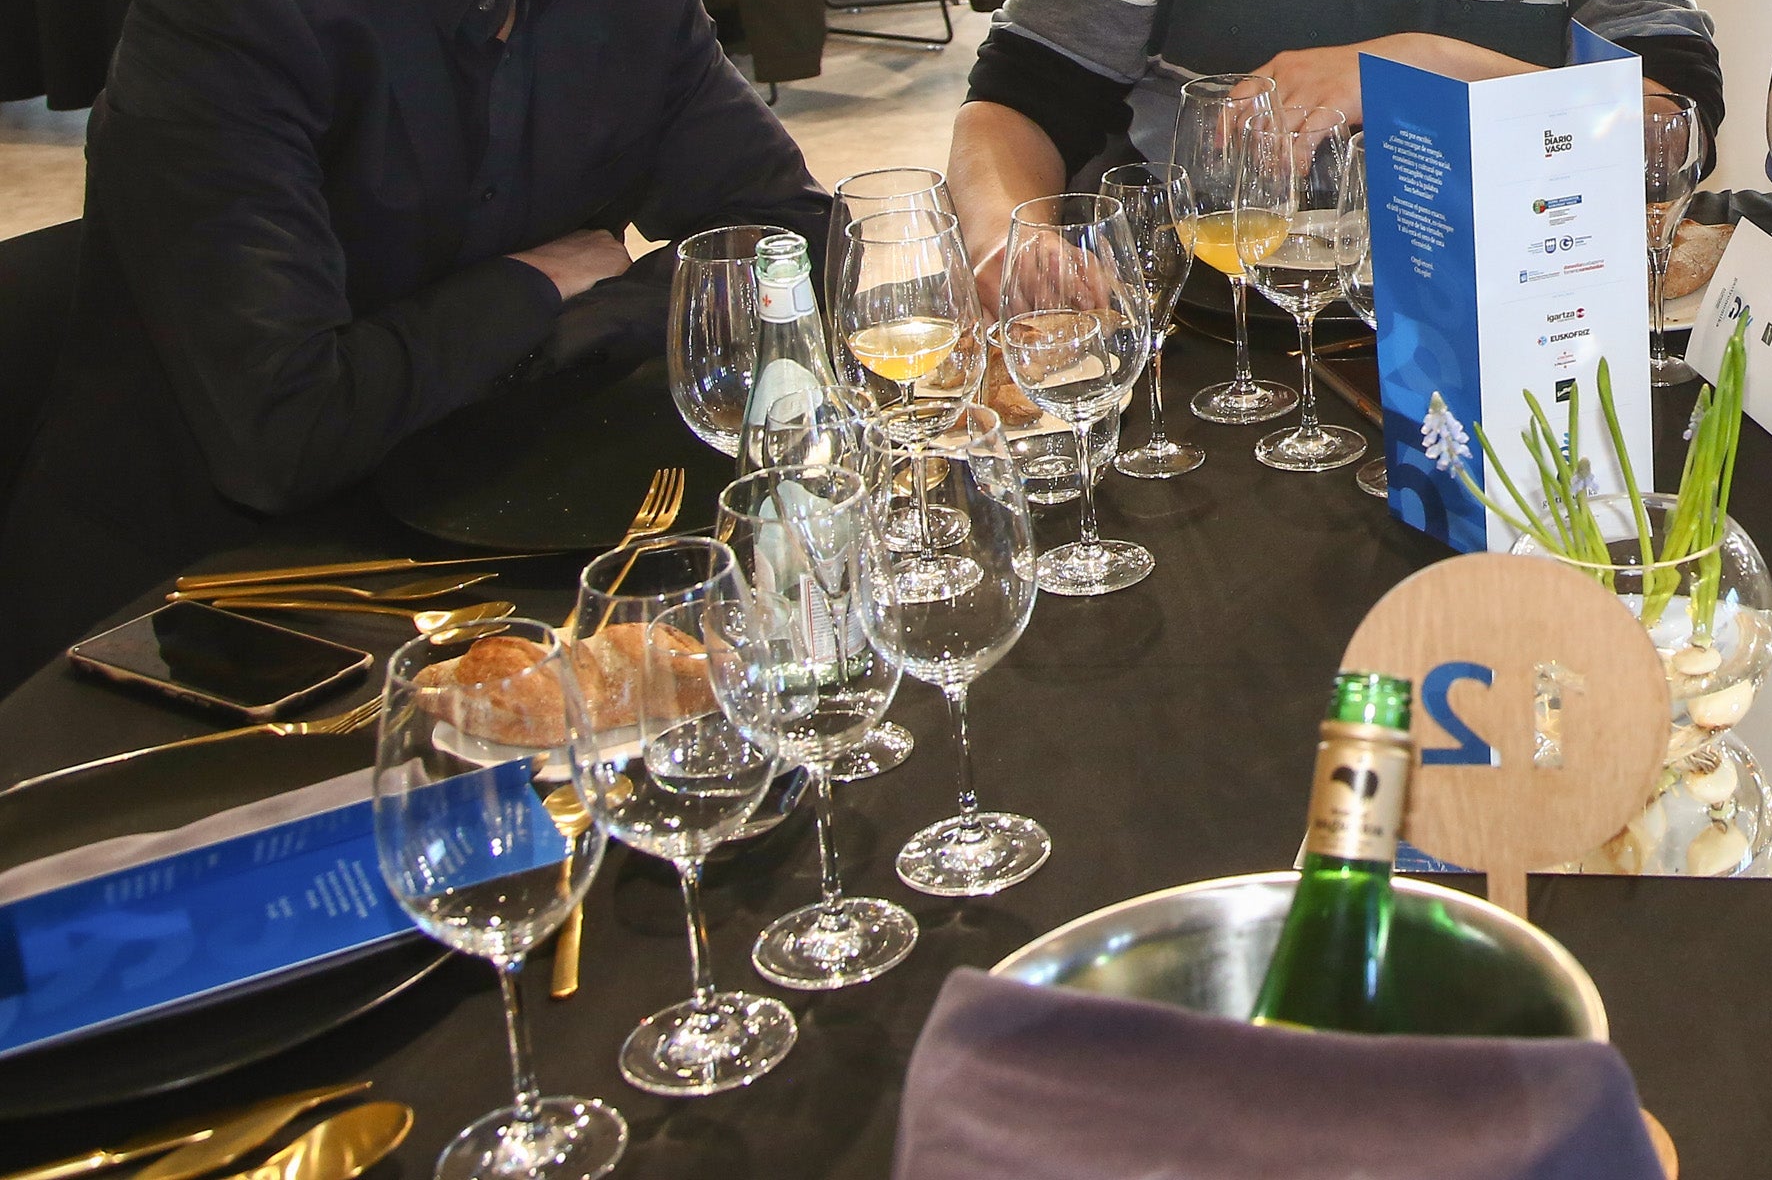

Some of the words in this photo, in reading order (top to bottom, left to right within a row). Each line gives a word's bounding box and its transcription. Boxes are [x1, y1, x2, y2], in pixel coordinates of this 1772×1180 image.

[1544, 130, 1553, 138] EL
[1545, 135, 1572, 146] DIARIO
[1545, 143, 1571, 154] VASCO
[1547, 311, 1575, 322] igartza
[1551, 329, 1590, 342] EUSKOFRIZ
